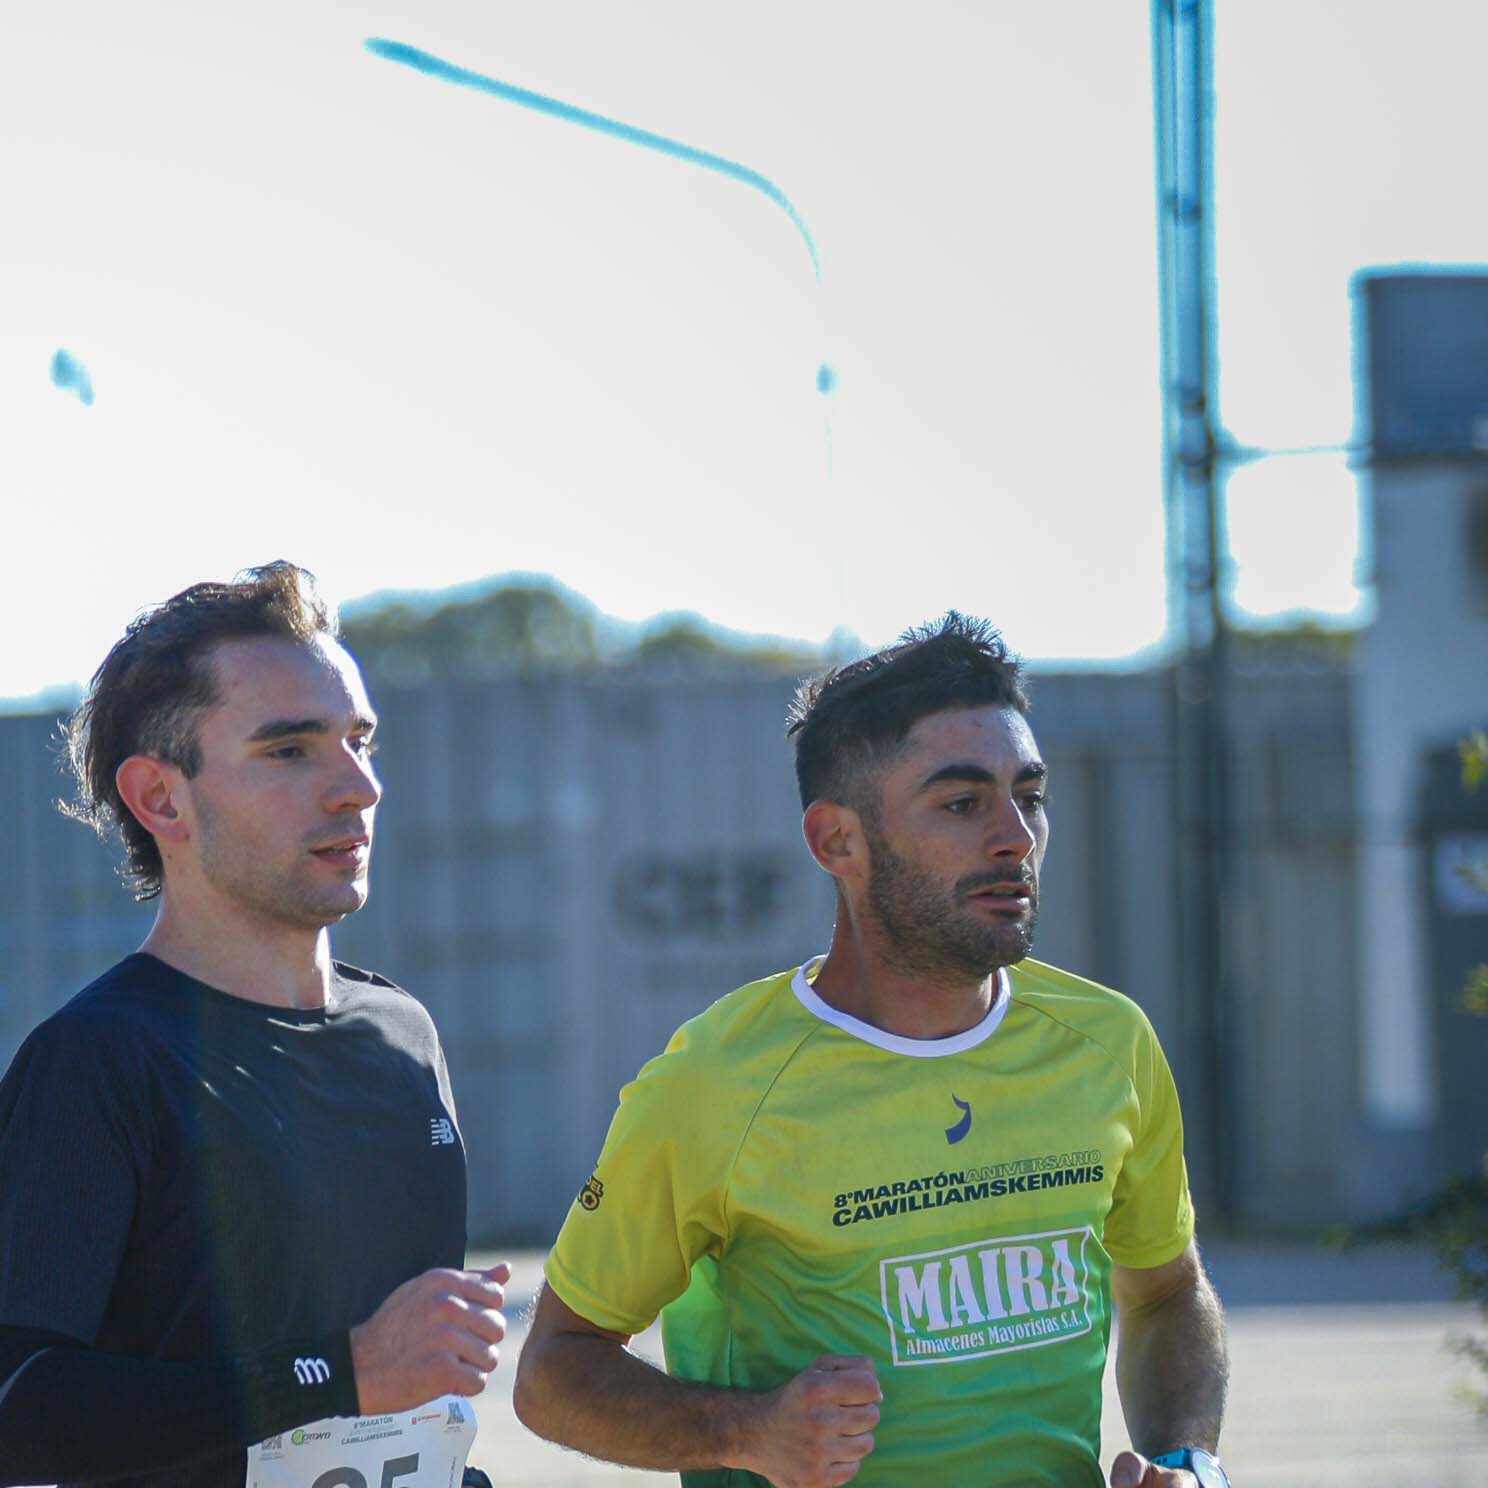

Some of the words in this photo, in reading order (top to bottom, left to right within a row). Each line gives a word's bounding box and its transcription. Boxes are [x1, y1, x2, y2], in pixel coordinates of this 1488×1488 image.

[832, 1165, 1104, 1228] CAWILLIAMSKEMMIS
[894, 1238, 1079, 1334] MAIRA
[906, 1330, 985, 1356] Almacenes
[987, 1315, 1060, 1345] Mayoristas
